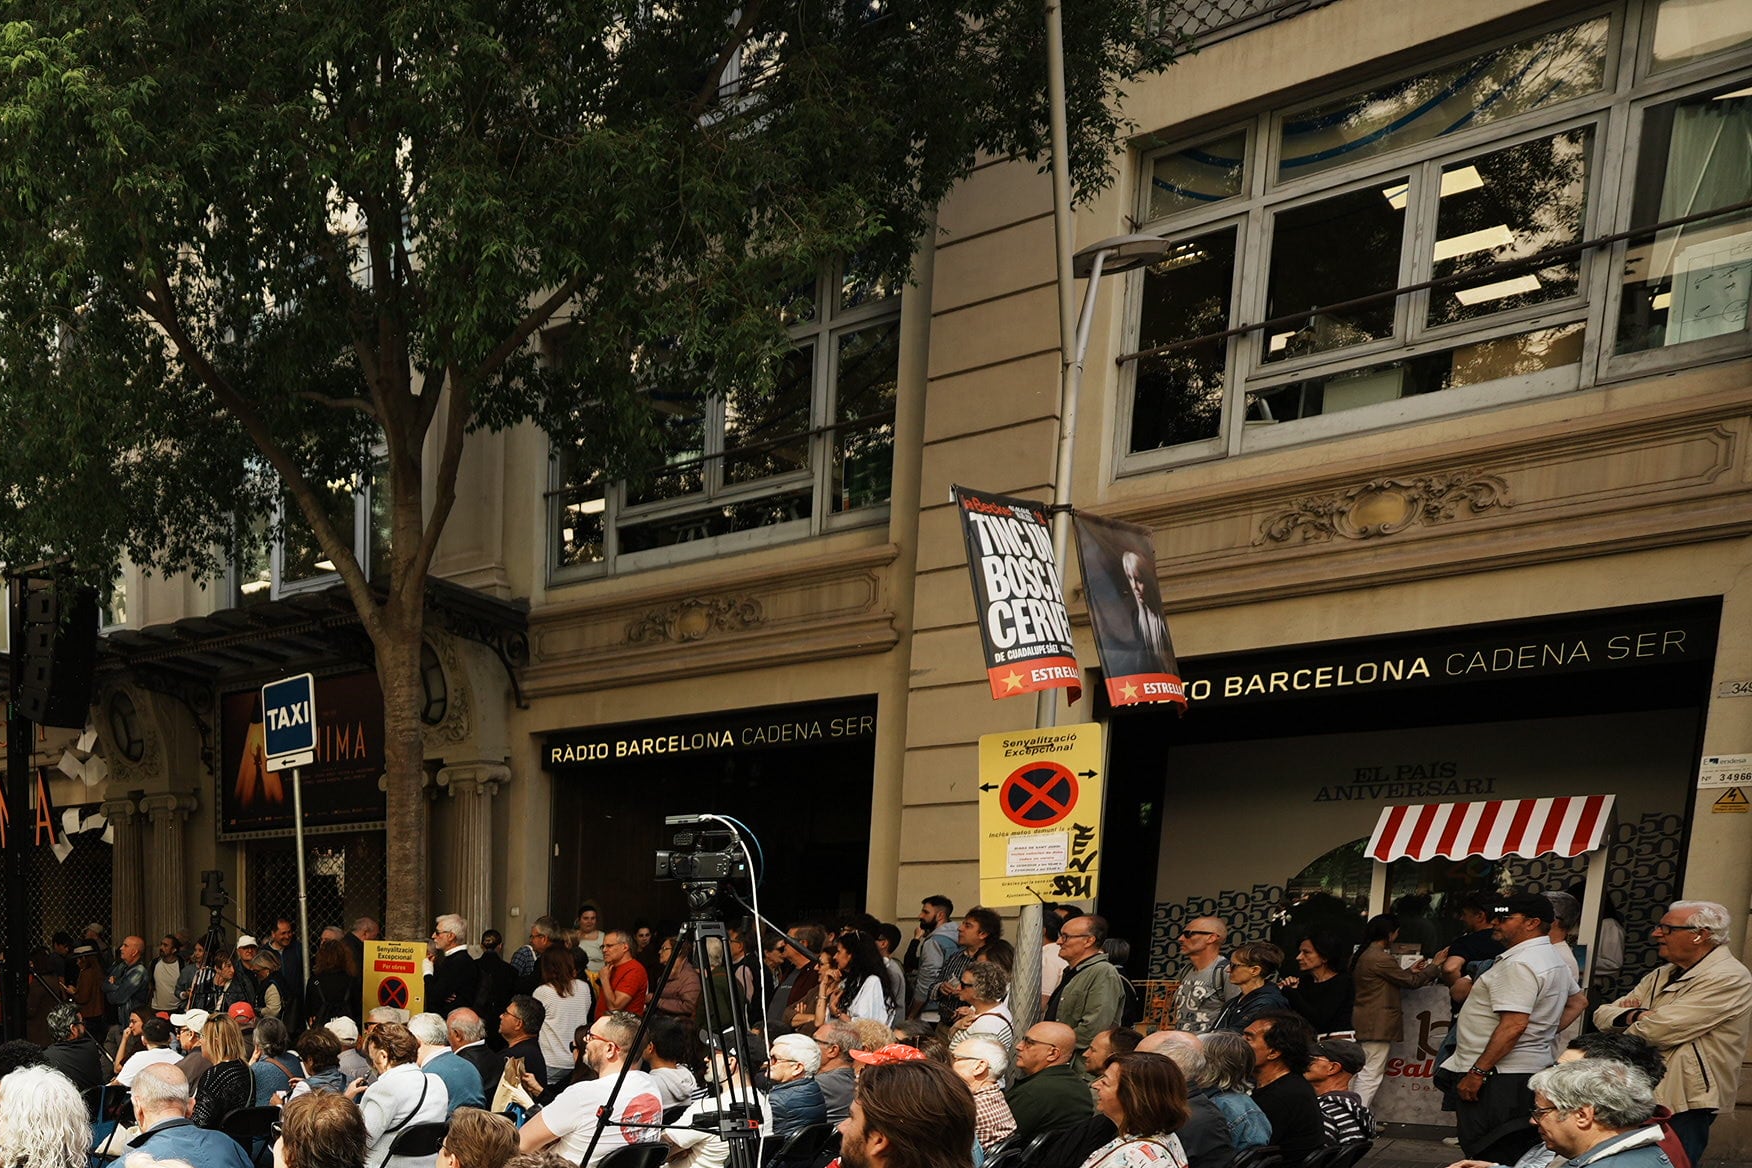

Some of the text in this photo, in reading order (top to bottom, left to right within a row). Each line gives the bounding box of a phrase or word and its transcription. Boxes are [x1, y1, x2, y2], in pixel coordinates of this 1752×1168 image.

[969, 511, 1033, 559] TINC
[981, 554, 1056, 602] BOSC
[994, 651, 1006, 663] DE
[1007, 645, 1046, 660] GUADALUPE
[1446, 630, 1687, 676] CADENA SER
[1224, 657, 1431, 697] BARCELONA
[266, 700, 309, 731] TAXI
[551, 715, 874, 763] RÀDIO BARCELONA CADENA SER
[1002, 733, 1077, 749] Senyalització
[1004, 743, 1073, 758] Excepcional
[1352, 766, 1391, 783] EL
[1313, 777, 1497, 802] ANIVERSARI
[1217, 890, 1250, 911] 50
[1250, 884, 1282, 905] 50
[1154, 902, 1185, 922] 50
[377, 945, 414, 954] Senyalització
[378, 952, 412, 960] Excepcional
[1385, 1057, 1436, 1078] Sal
